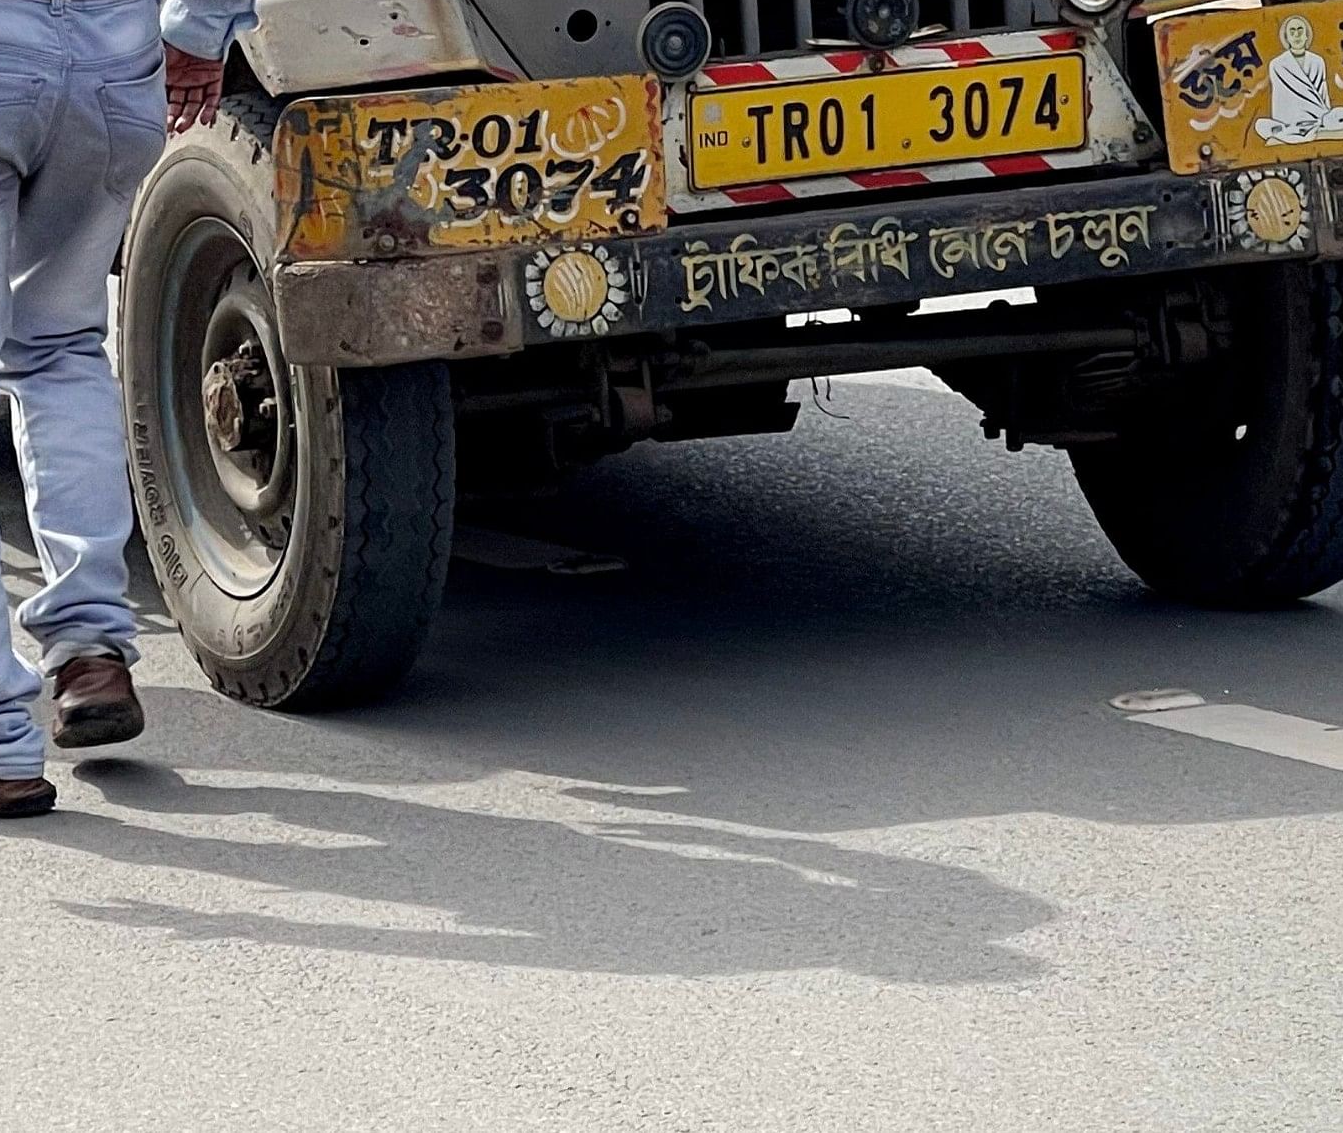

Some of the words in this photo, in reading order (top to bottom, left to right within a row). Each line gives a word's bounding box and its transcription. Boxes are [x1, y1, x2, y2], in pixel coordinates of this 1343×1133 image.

[1178, 30, 1264, 109] জয়
[698, 130, 729, 151] IND
[746, 93, 877, 165] TR01
[927, 72, 1061, 143] 3074
[442, 150, 650, 221] 3074
[680, 233, 821, 312] ট্রাফিক
[823, 216, 919, 287] বিধি
[928, 219, 1036, 279] মেনে
[1043, 204, 1157, 268] চলুন
